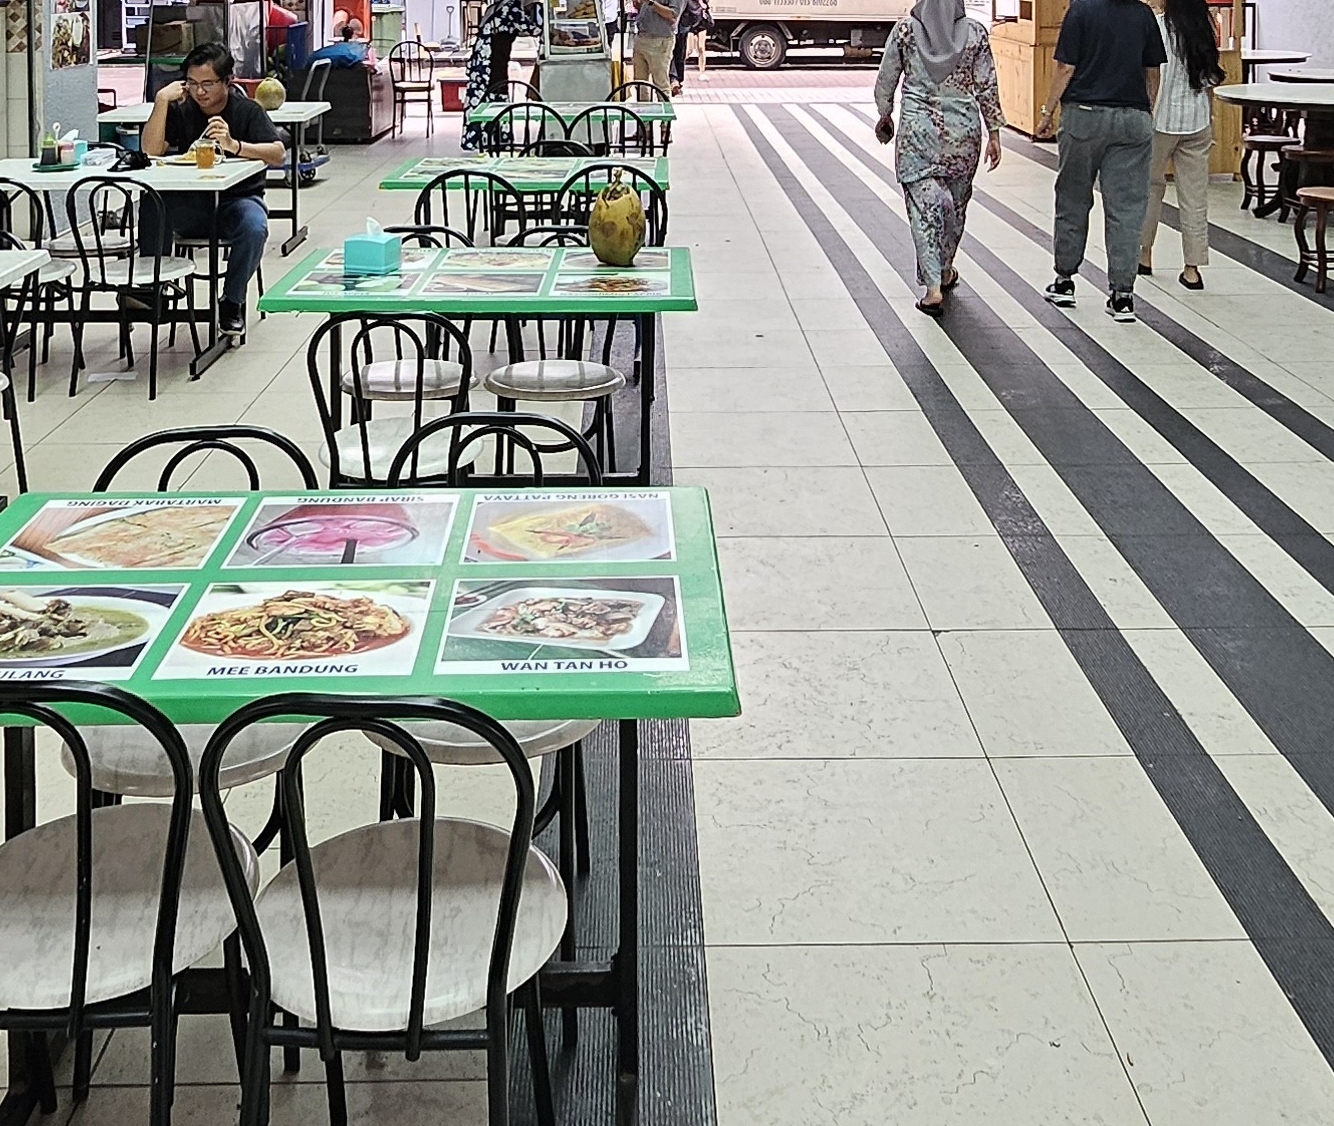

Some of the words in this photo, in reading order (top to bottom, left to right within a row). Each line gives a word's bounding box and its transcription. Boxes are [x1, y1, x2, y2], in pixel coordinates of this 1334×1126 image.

[66, 499, 134, 507] DAGING
[483, 494, 552, 502] PATTAYA
[206, 665, 251, 676] MEE
[254, 663, 359, 676] BANDUNG
[499, 660, 549, 671] WAN
[554, 659, 590, 671] TAN
[599, 659, 629, 671] HO
